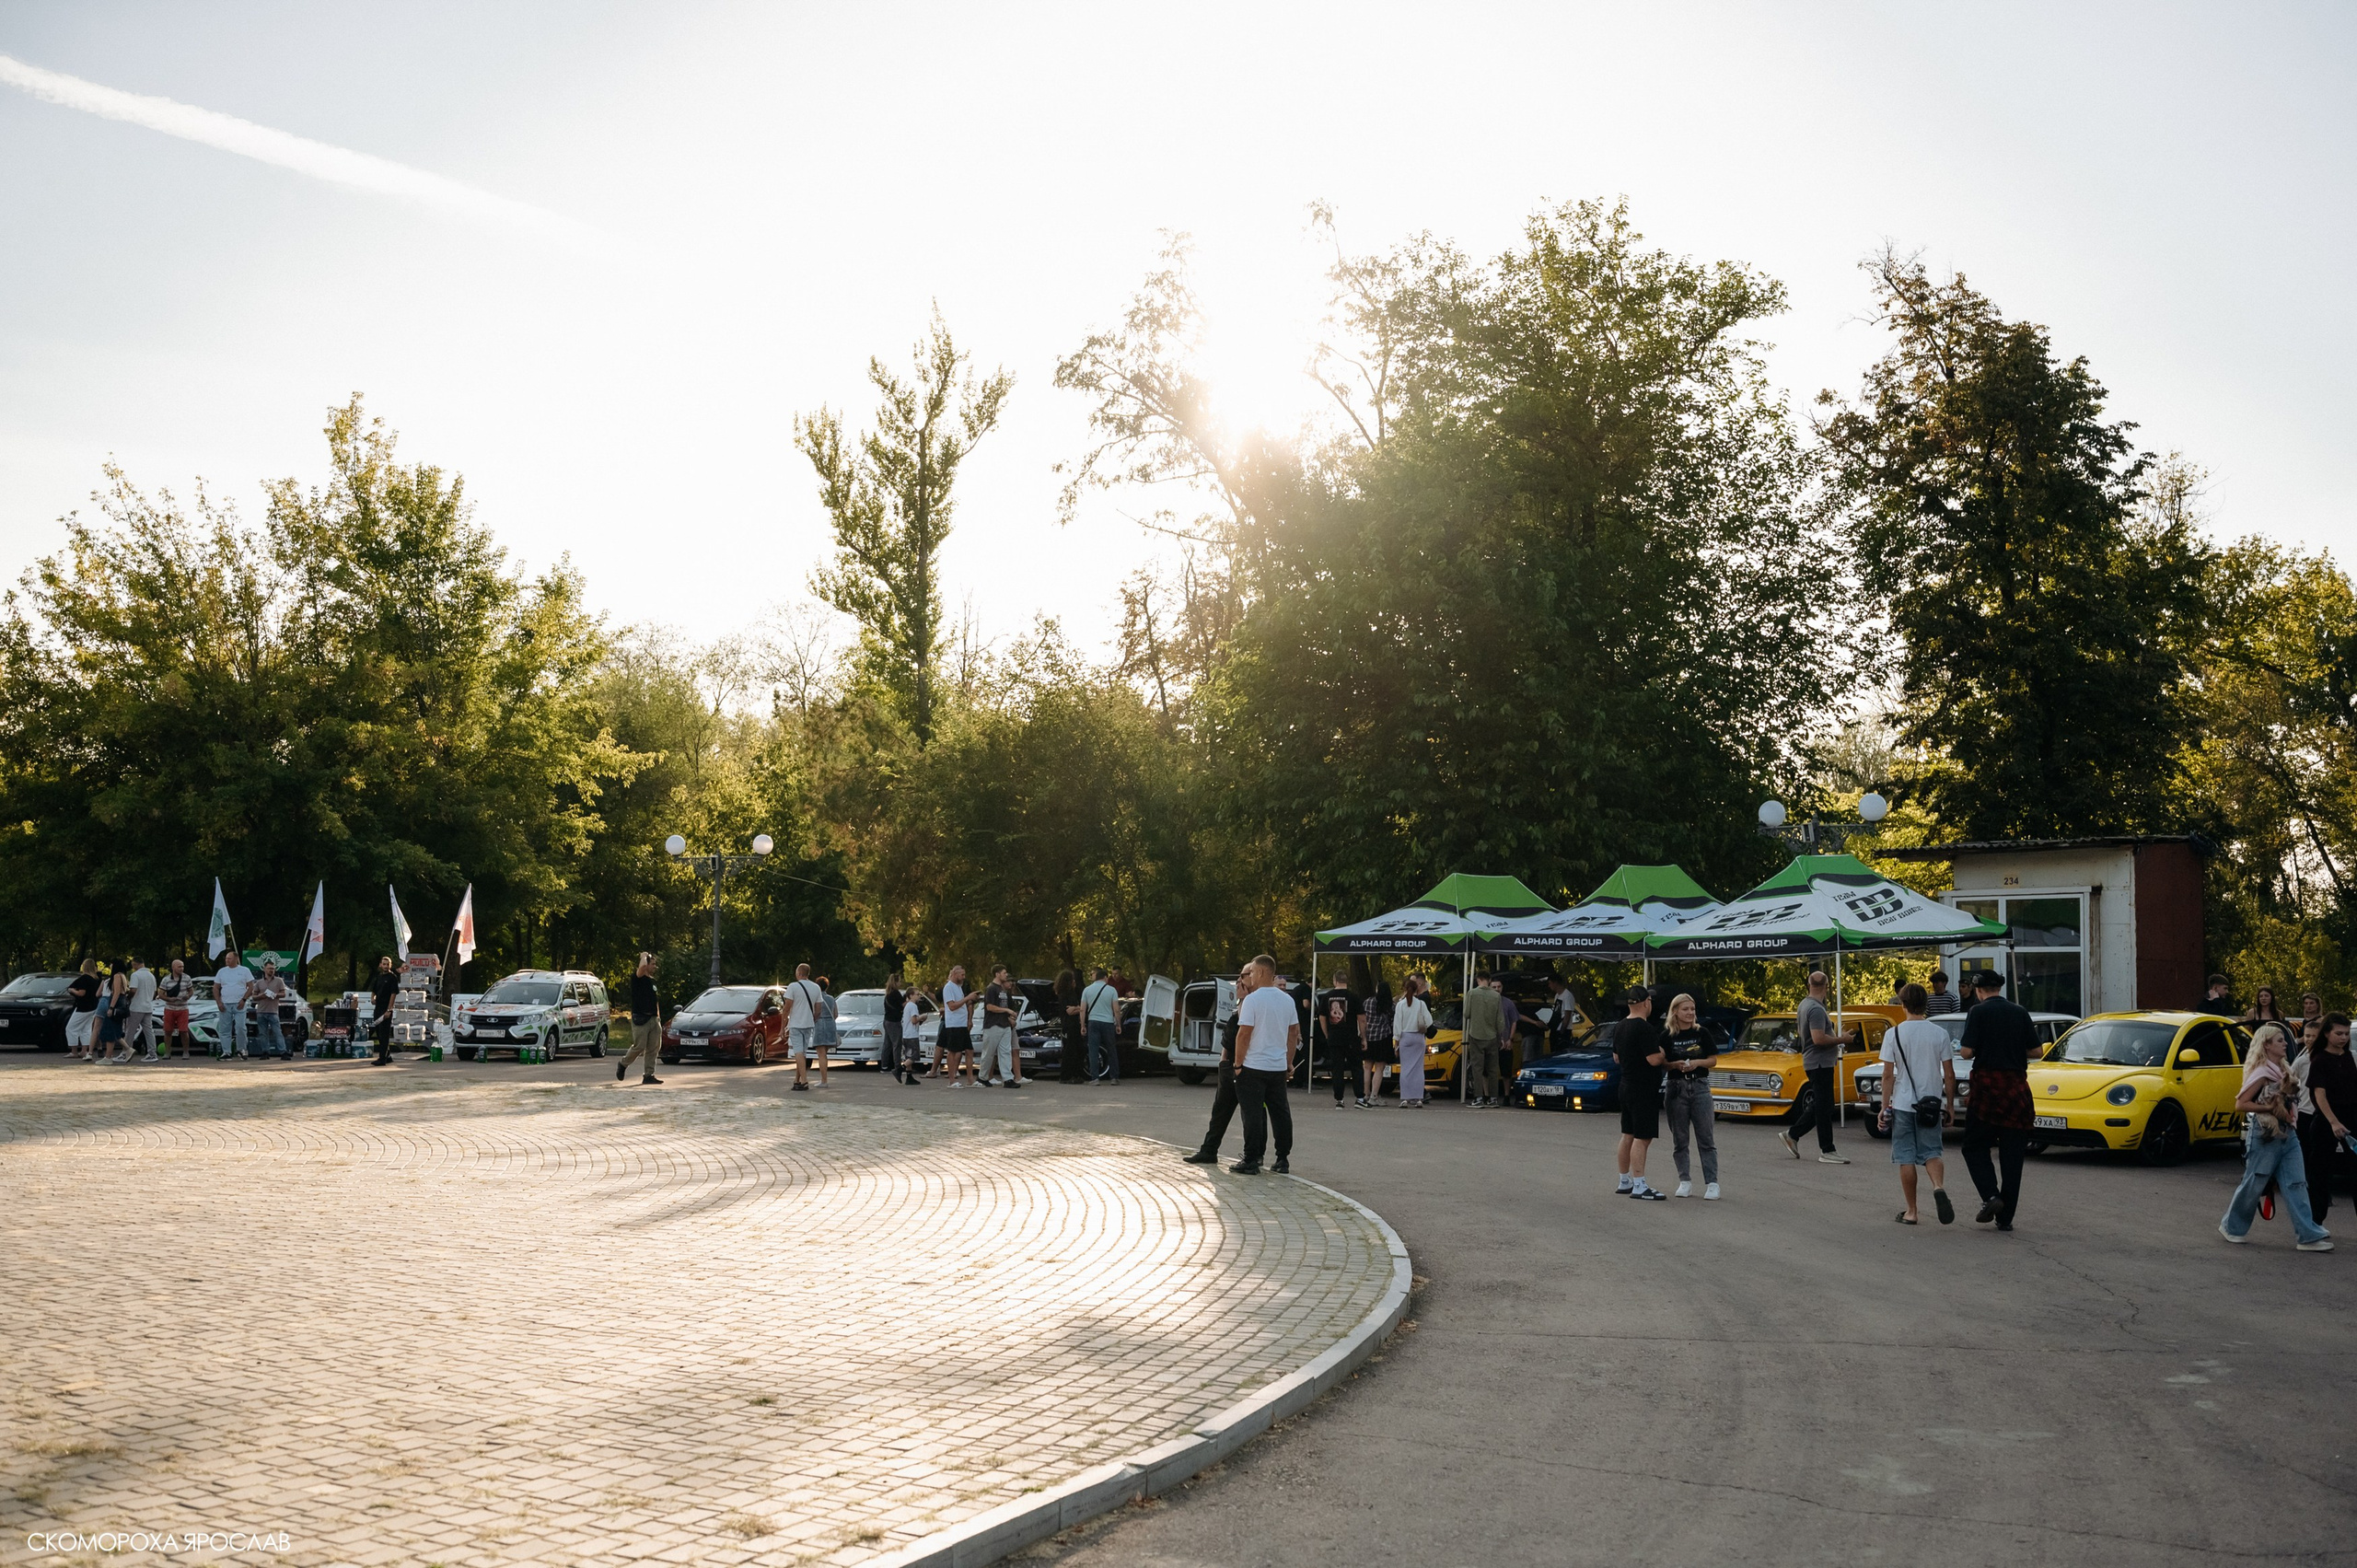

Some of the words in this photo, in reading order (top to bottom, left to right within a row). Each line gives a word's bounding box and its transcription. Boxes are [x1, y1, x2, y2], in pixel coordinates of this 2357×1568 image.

[2003, 877, 2019, 886] 234
[1514, 937, 1562, 946] ALPHARD
[1565, 938, 1603, 947] GROUP
[1687, 940, 1743, 950] ALPHARD
[1747, 938, 1788, 948] GROUP
